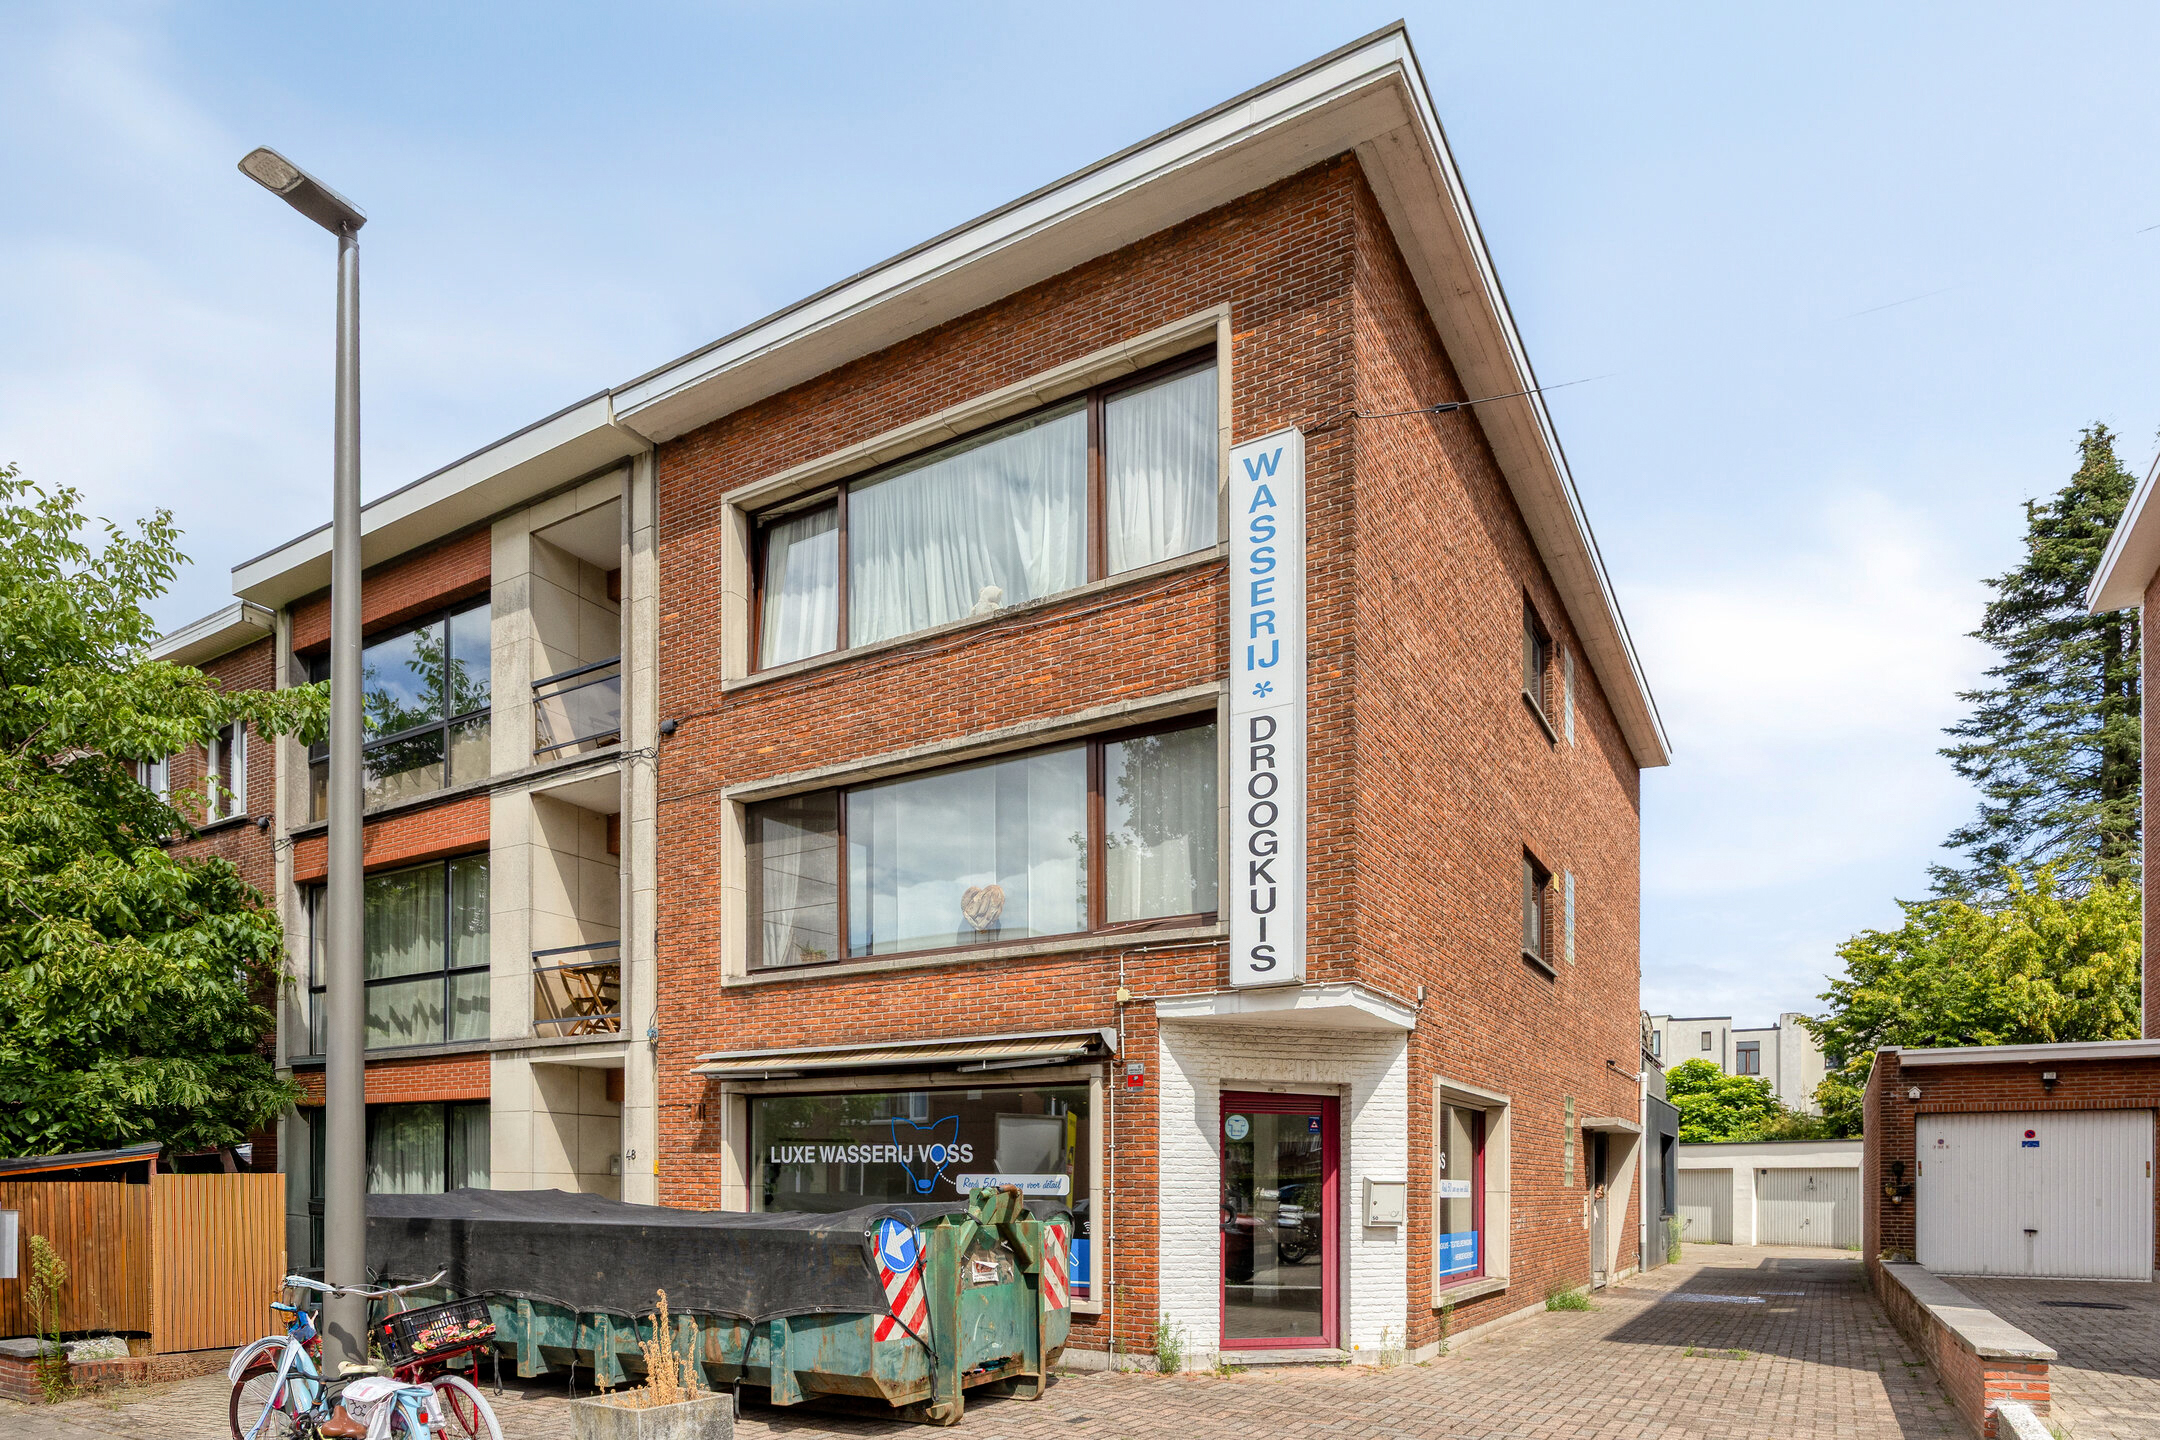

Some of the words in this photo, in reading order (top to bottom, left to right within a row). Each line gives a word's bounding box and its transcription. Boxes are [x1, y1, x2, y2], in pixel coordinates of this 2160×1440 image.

[1243, 447, 1283, 671] WASSERIJ
[1248, 715, 1279, 972] DROOGKUIS
[626, 1149, 636, 1160] 48
[771, 1146, 815, 1163] LUXE
[820, 1145, 913, 1163] WASSERIJ
[918, 1143, 974, 1164] VOSS
[983, 1177, 997, 1188] 50
[1043, 1178, 1062, 1189] detail
